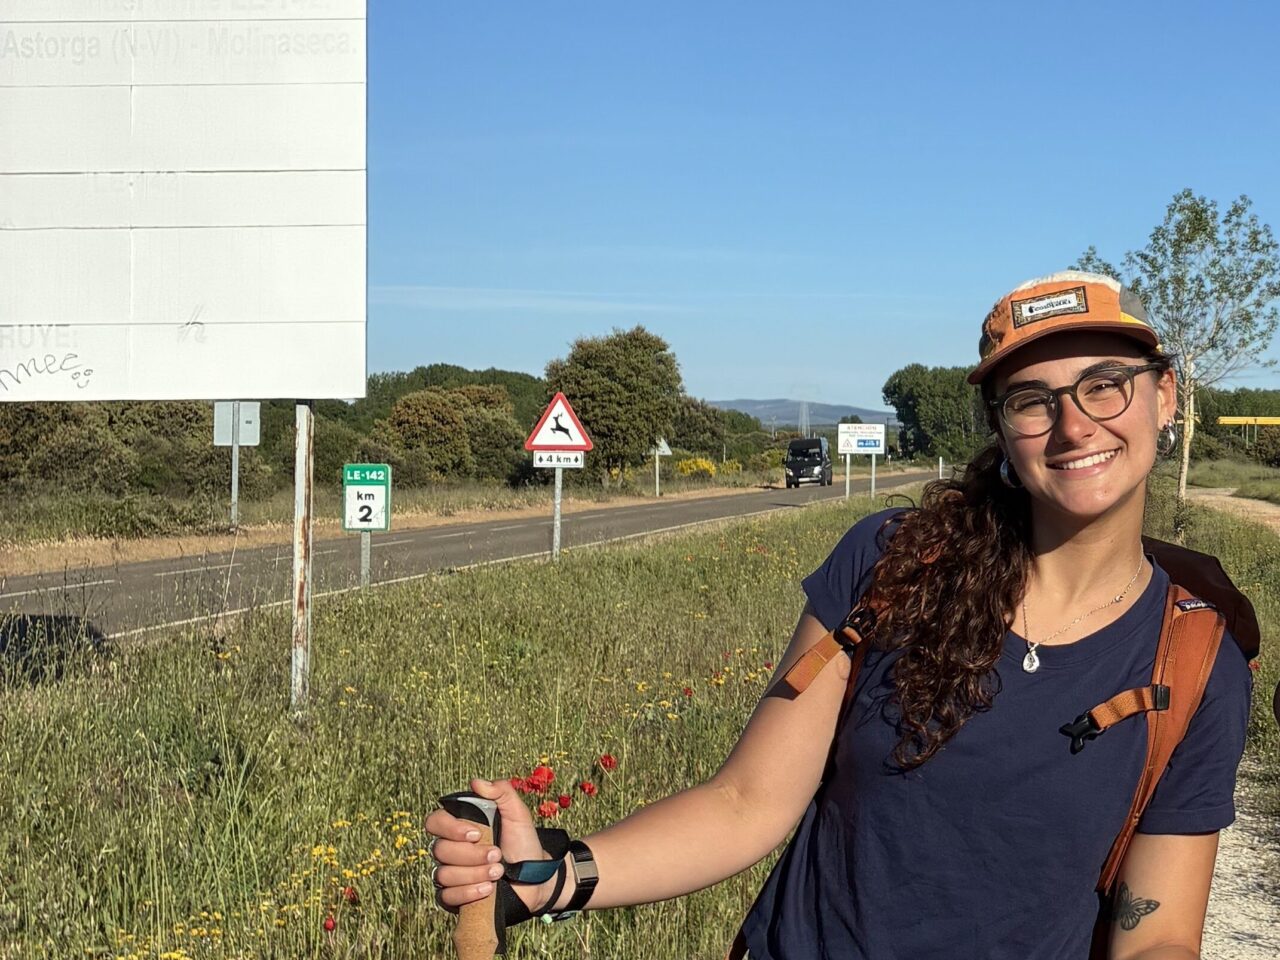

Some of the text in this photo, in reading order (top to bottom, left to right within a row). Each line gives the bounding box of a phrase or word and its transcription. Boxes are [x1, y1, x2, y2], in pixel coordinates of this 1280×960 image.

[1, 29, 101, 64] Astorga
[546, 455, 572, 463] 4 km
[347, 470, 385, 480] LE-142
[357, 491, 375, 501] km
[358, 505, 373, 523] 2
